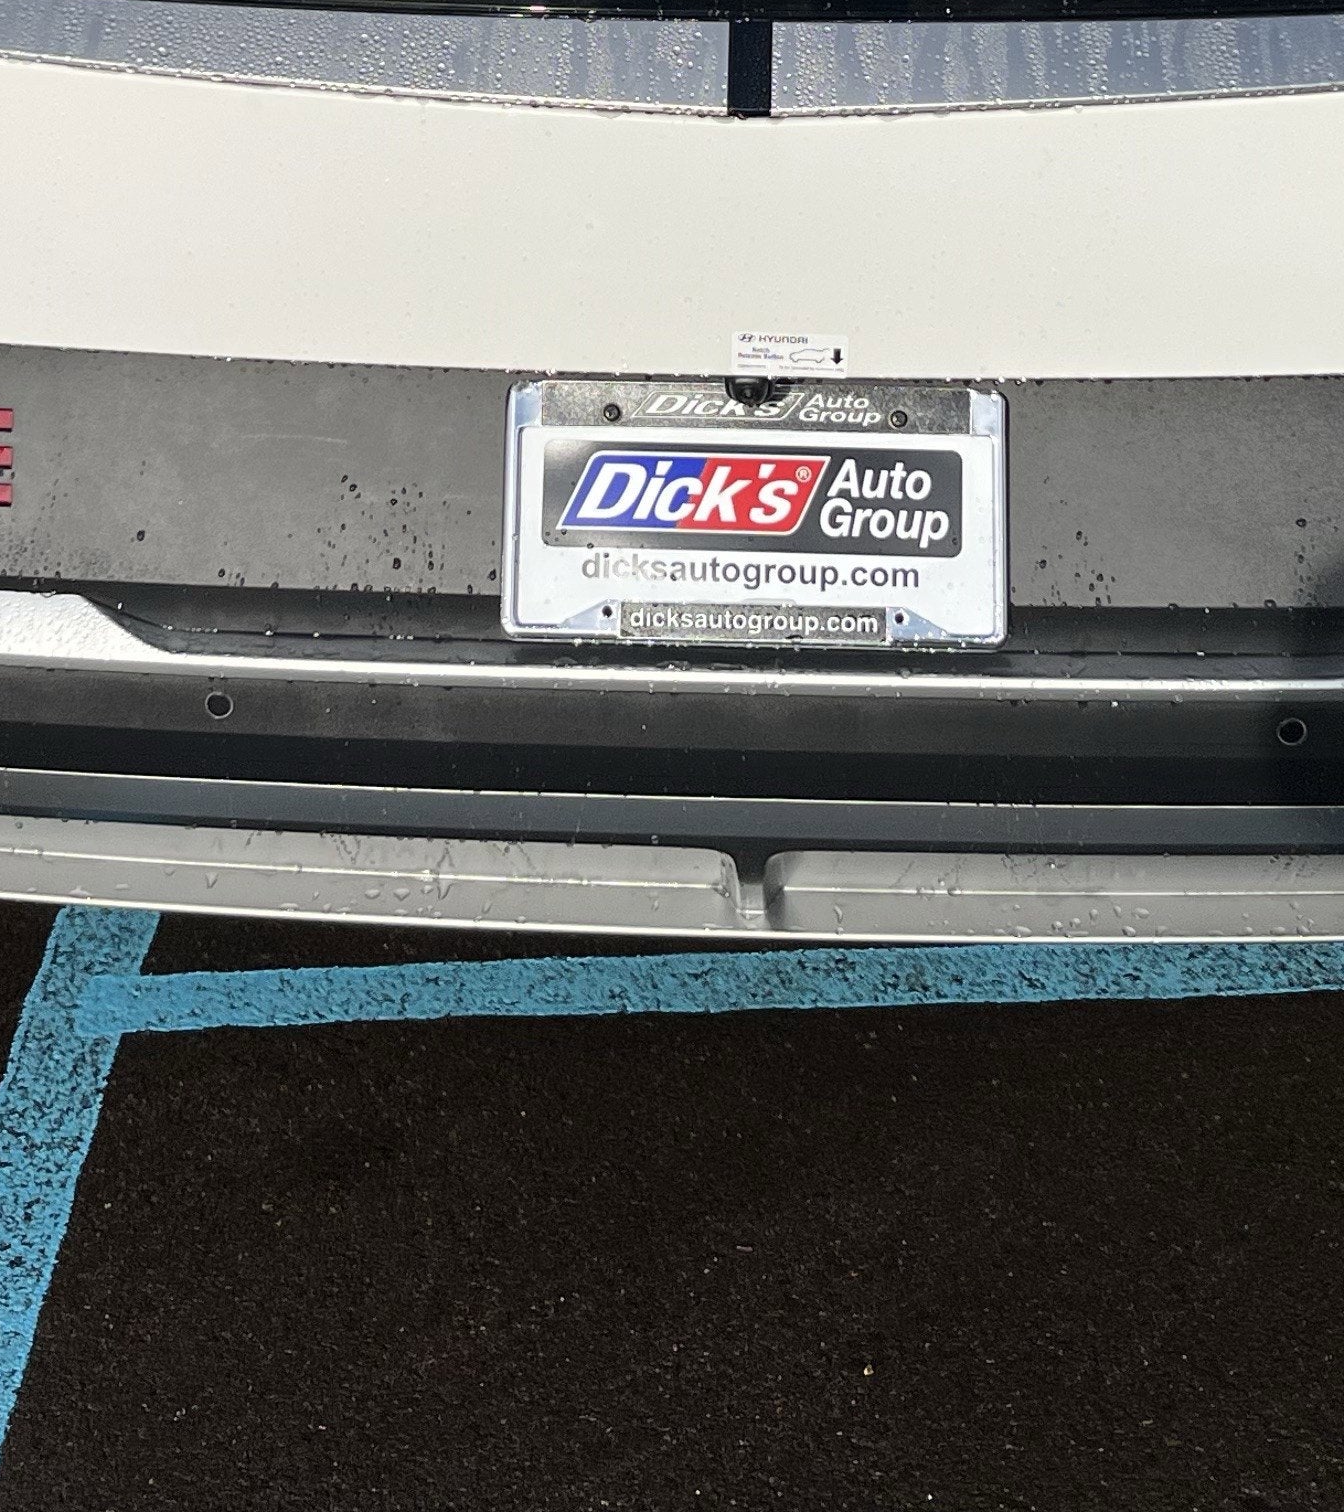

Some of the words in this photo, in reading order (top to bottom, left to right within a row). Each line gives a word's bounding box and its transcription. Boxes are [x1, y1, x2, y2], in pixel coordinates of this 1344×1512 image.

[758, 335, 808, 344] HYUNDAI
[645, 394, 785, 416] Dicks
[805, 394, 869, 409] Auto
[798, 408, 882, 426] Group
[827, 458, 932, 501] Auto
[820, 498, 949, 548] Group
[581, 553, 920, 591] dicksautogroup.com
[629, 607, 878, 635] dicksautogroup.com
